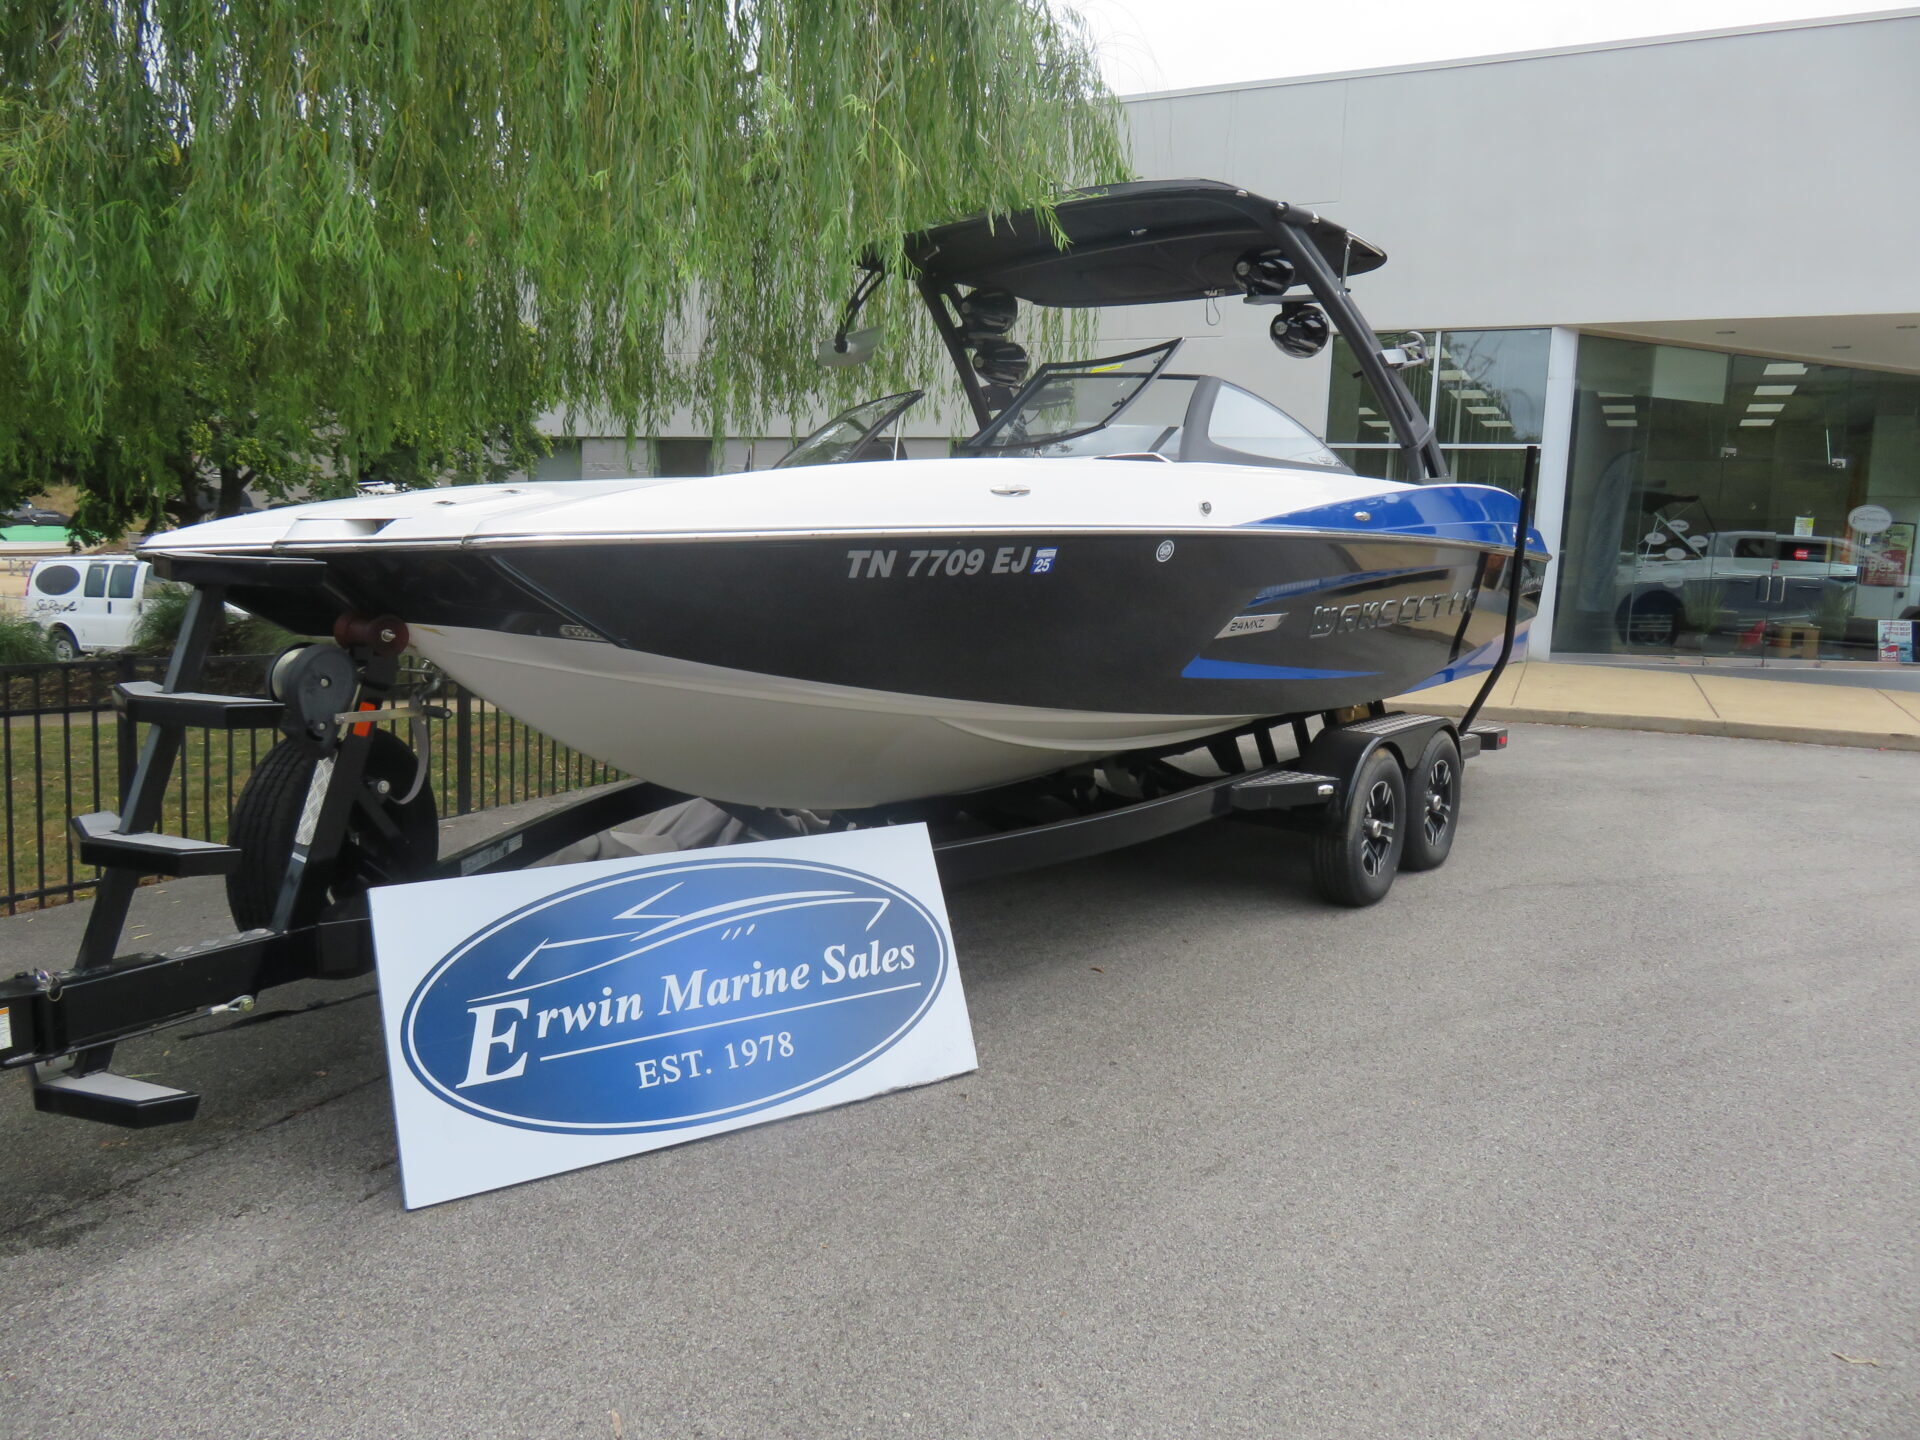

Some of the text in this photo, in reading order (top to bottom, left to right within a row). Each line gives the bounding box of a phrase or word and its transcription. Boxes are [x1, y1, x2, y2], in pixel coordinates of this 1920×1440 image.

[847, 546, 1031, 578] TN 7709 EJ
[1034, 558, 1053, 572] 25
[455, 939, 916, 1089] Erwin Marine Sales
[636, 1031, 795, 1089] EST. 1978
